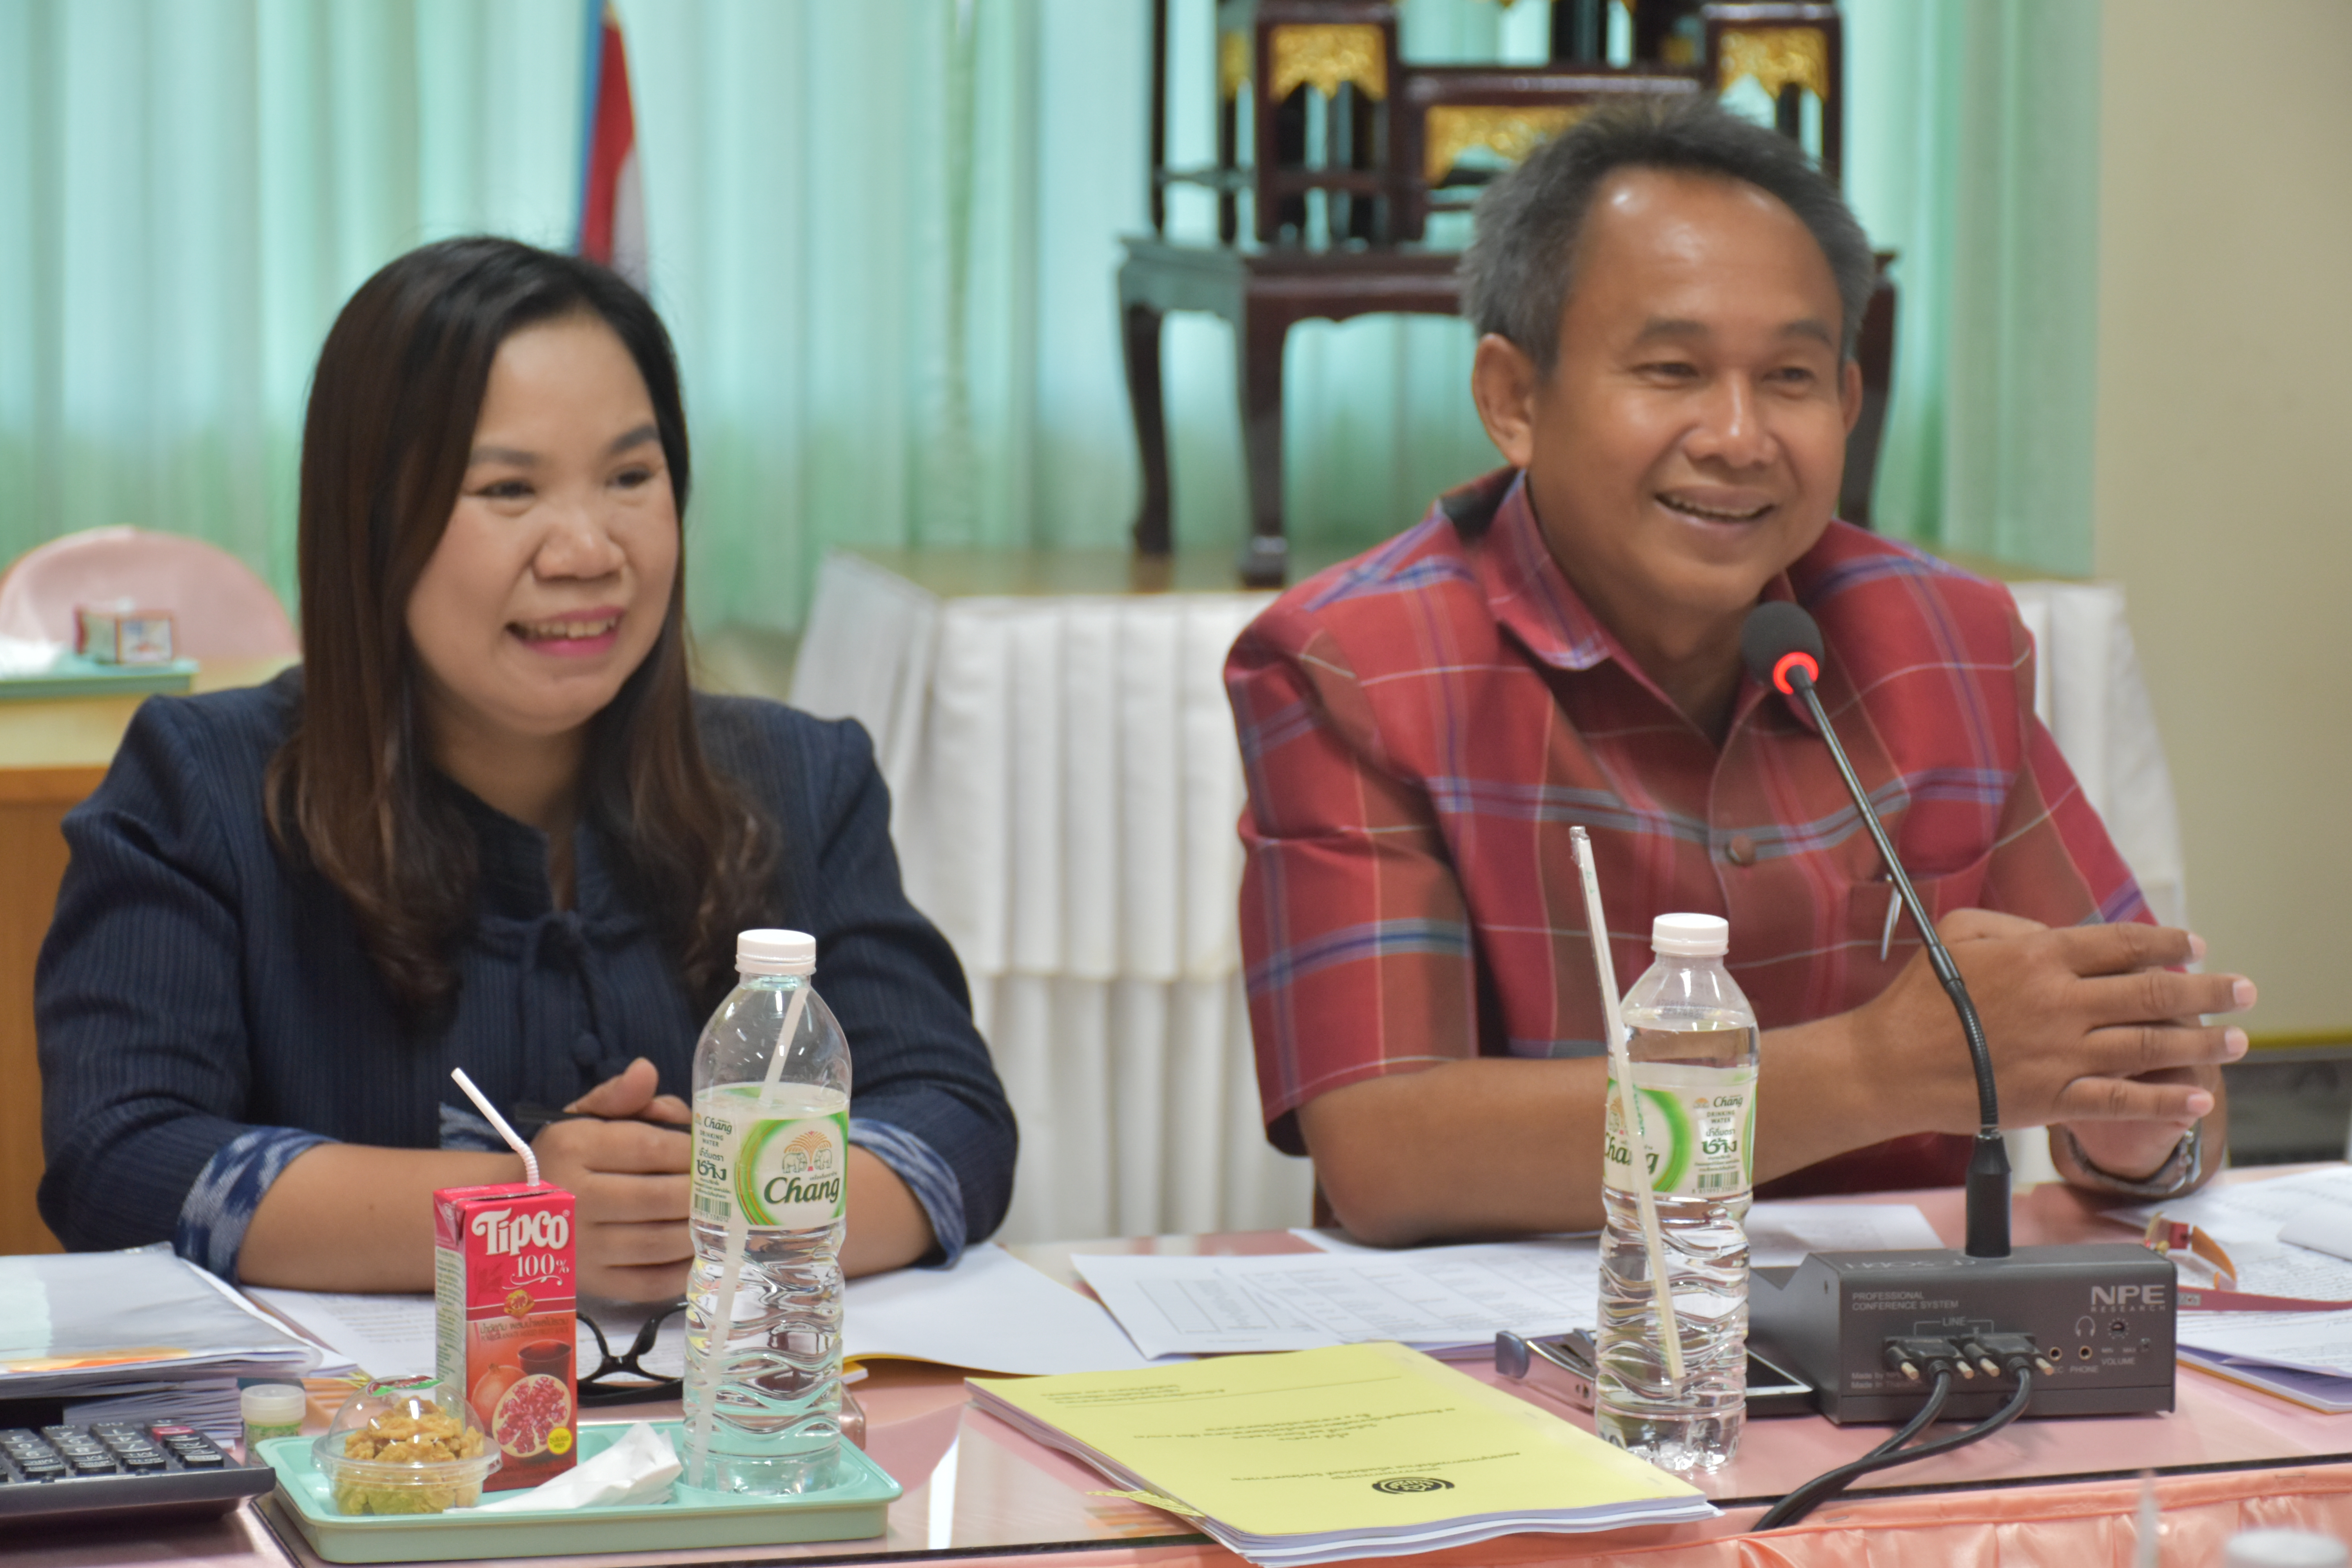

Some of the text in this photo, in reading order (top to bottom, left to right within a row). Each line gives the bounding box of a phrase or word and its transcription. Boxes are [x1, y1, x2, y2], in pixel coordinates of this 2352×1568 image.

[1714, 1096, 1743, 1108] Chang
[704, 1116, 732, 1135] Chang
[700, 1130, 723, 1141] DRINKING
[702, 1138, 719, 1147] WATER
[1605, 1132, 1659, 1175] hag
[764, 1176, 840, 1204] Chang
[472, 1207, 569, 1256] Tipco
[515, 1253, 570, 1278] 100%
[1852, 1291, 1924, 1300] PROFESSIONAL
[2091, 1284, 2166, 1305] NPE
[1852, 1300, 1959, 1311] CONFERENCE SYSTEM
[1942, 1317, 1966, 1327] LINE
[2101, 1357, 2135, 1365] VOLUME
